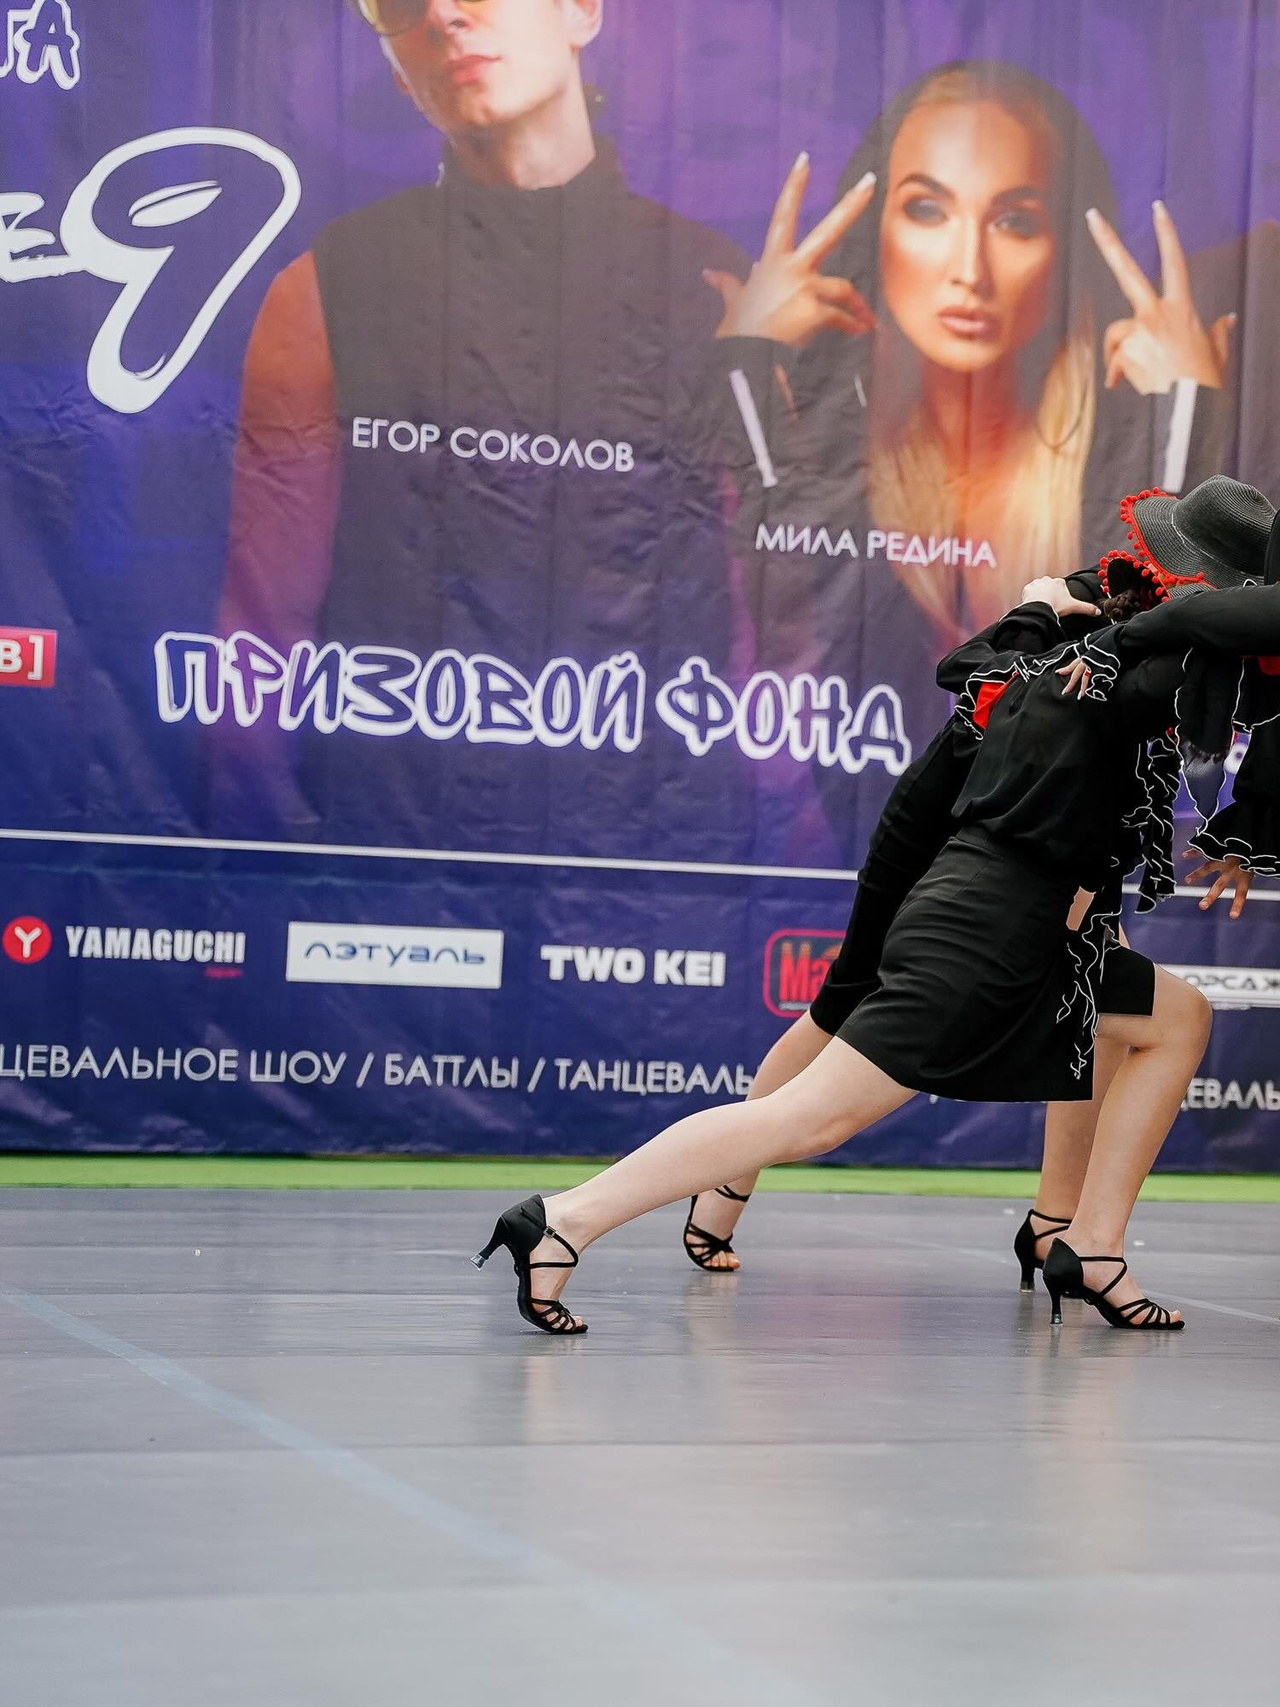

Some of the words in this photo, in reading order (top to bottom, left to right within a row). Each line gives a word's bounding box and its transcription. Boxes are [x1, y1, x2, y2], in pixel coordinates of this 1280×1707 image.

[352, 416, 441, 454] ЕГОР
[449, 426, 635, 472] СОКОЛОВ
[755, 523, 859, 558] МИЛА
[867, 529, 997, 568] РЕДИНА
[154, 630, 646, 754] ПРИЗОВОЙ
[656, 655, 912, 777] ФОНД
[65, 926, 246, 964] YAMAGUCHI
[540, 945, 646, 984] TWO
[653, 949, 727, 987] KEI
[0, 1043, 239, 1082] ЦЕВАЛЬНОЕ
[249, 1049, 347, 1085] ШОУ
[384, 1053, 519, 1088] БАТТЛЫ
[554, 1058, 755, 1097] ТАНЦЕВАЛЬ
